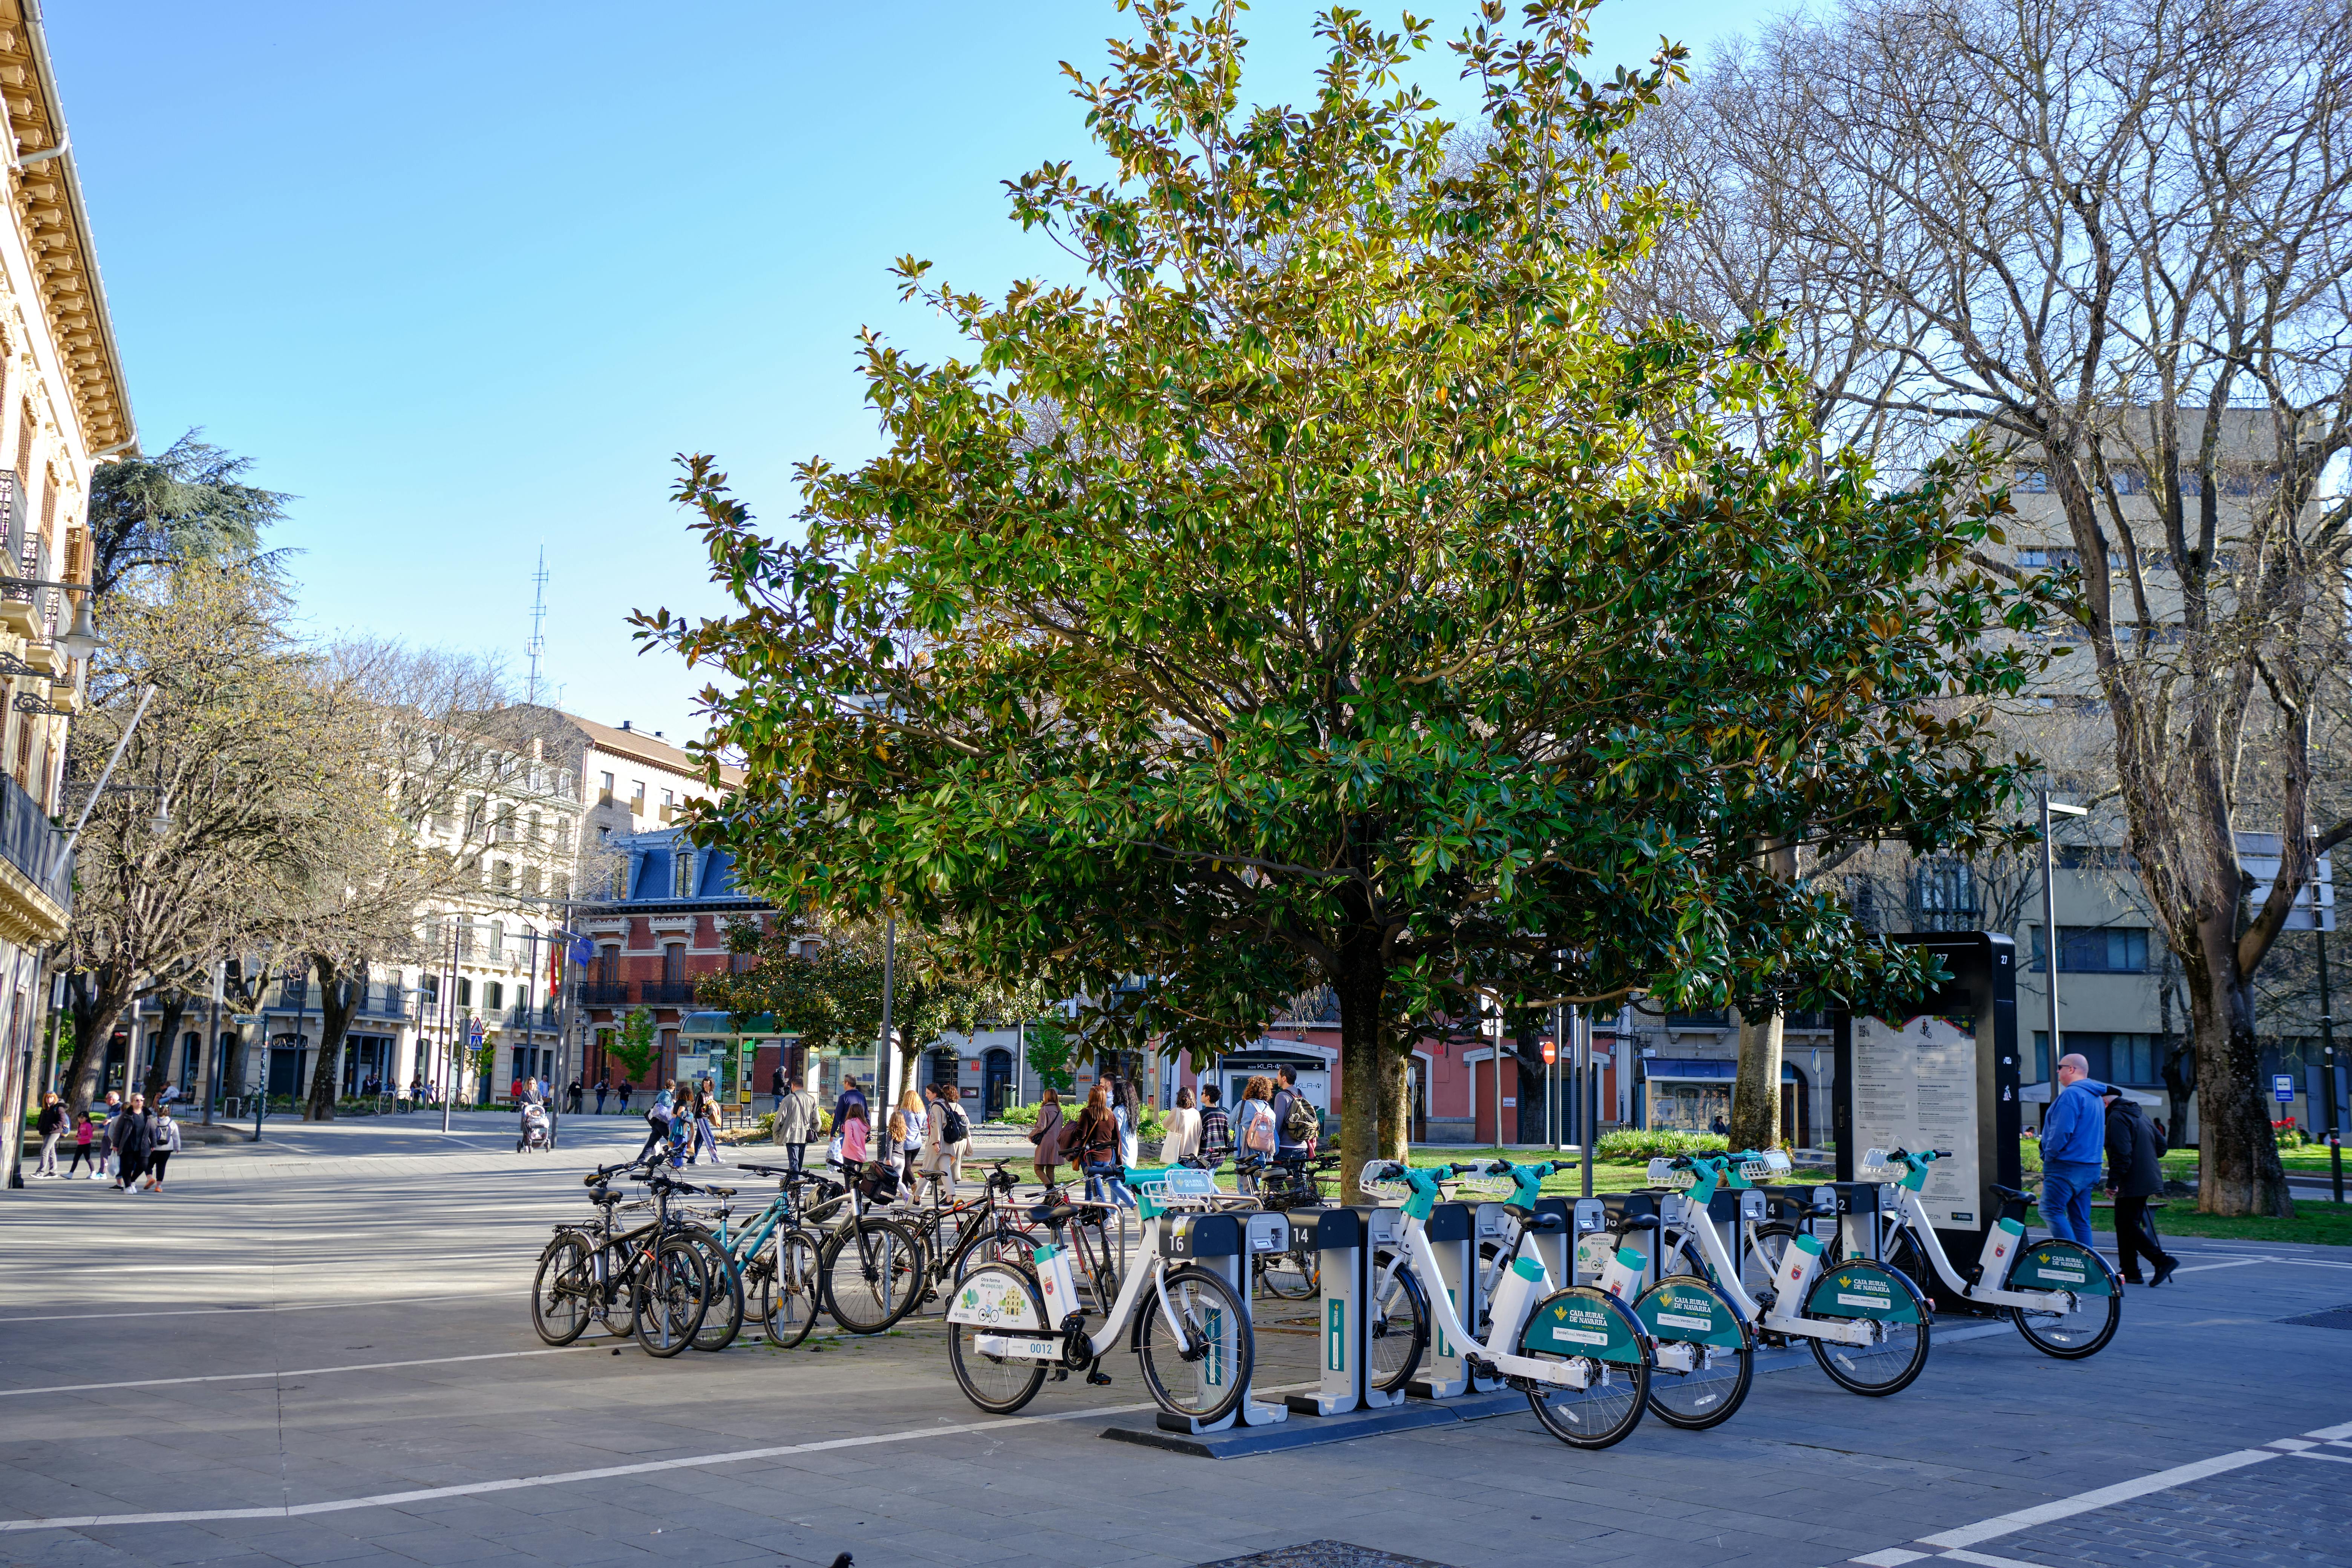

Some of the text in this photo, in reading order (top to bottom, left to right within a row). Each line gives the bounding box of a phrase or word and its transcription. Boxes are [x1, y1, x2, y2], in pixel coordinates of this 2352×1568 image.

[2001, 955, 2007, 965] 27
[1294, 1228, 1309, 1243] 14
[1169, 1236, 1184, 1252] 16
[1683, 1304, 1712, 1313] NAVARRA
[1585, 1311, 1605, 1320] RURAL
[1579, 1317, 1608, 1326] NAVARRA
[1030, 1343, 1052, 1354] 0012
